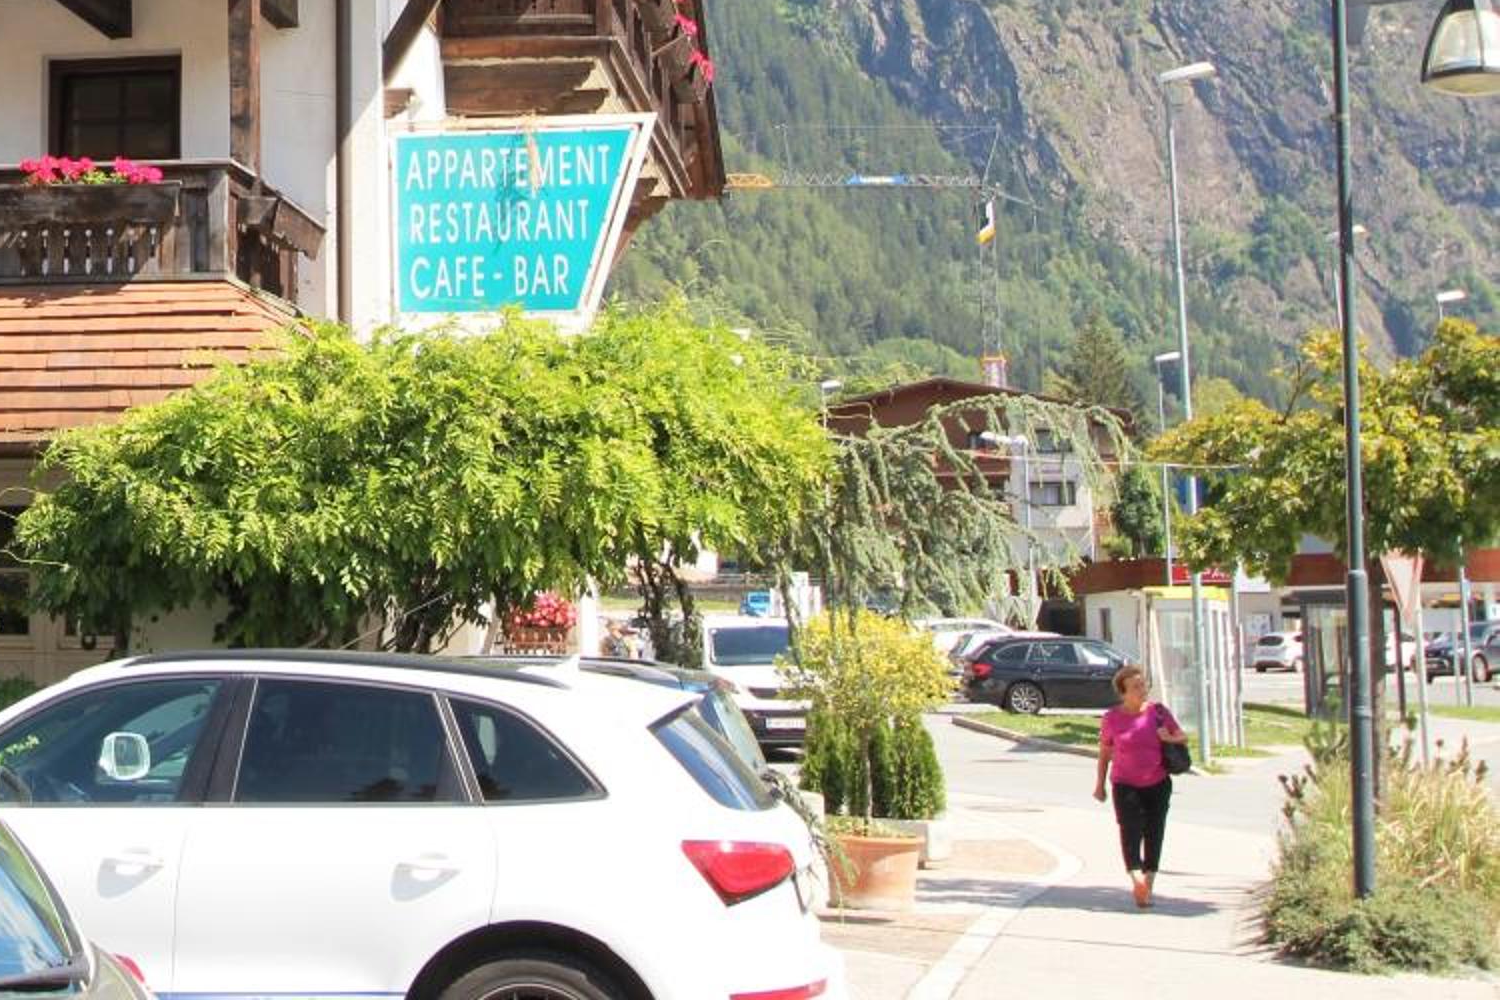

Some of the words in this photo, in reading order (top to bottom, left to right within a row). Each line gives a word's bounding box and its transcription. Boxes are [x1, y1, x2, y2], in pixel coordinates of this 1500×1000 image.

[405, 145, 610, 190] APPARTEMENT
[409, 199, 589, 243] RESTAURANT
[514, 254, 569, 295] BAR
